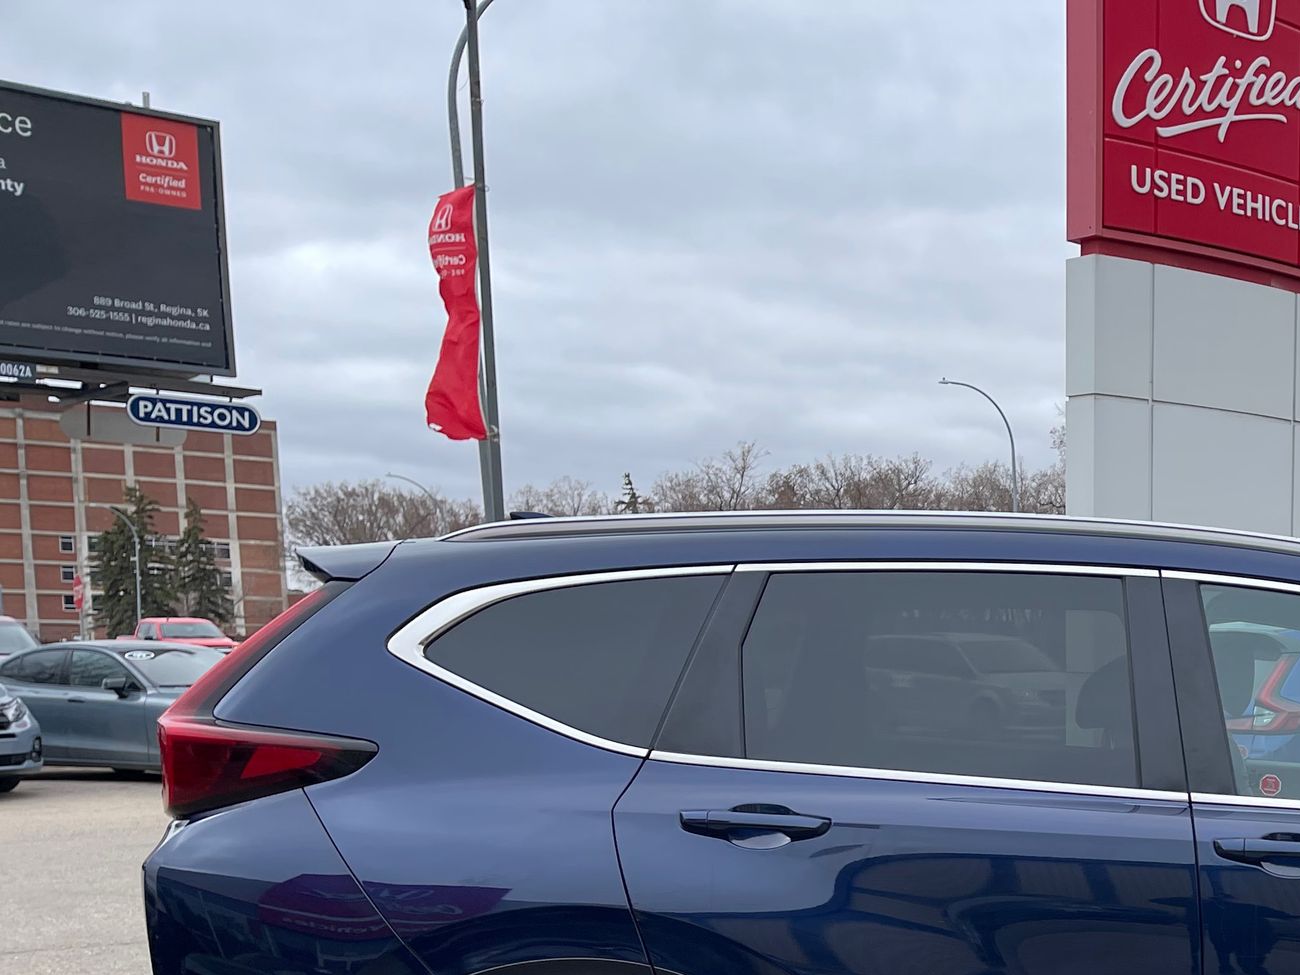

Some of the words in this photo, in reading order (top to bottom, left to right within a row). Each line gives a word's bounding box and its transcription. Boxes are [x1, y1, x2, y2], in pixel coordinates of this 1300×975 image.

[135, 154, 188, 170] HONDA
[138, 173, 186, 188] Certified
[1130, 164, 1206, 205] USED
[67, 306, 130, 322] 306-525-1555
[138, 315, 210, 331] reginahonda.ca
[114, 298, 142, 310] Broad
[160, 303, 195, 317] Regina,
[196, 307, 209, 318] SK
[138, 400, 249, 430] PATTISON
